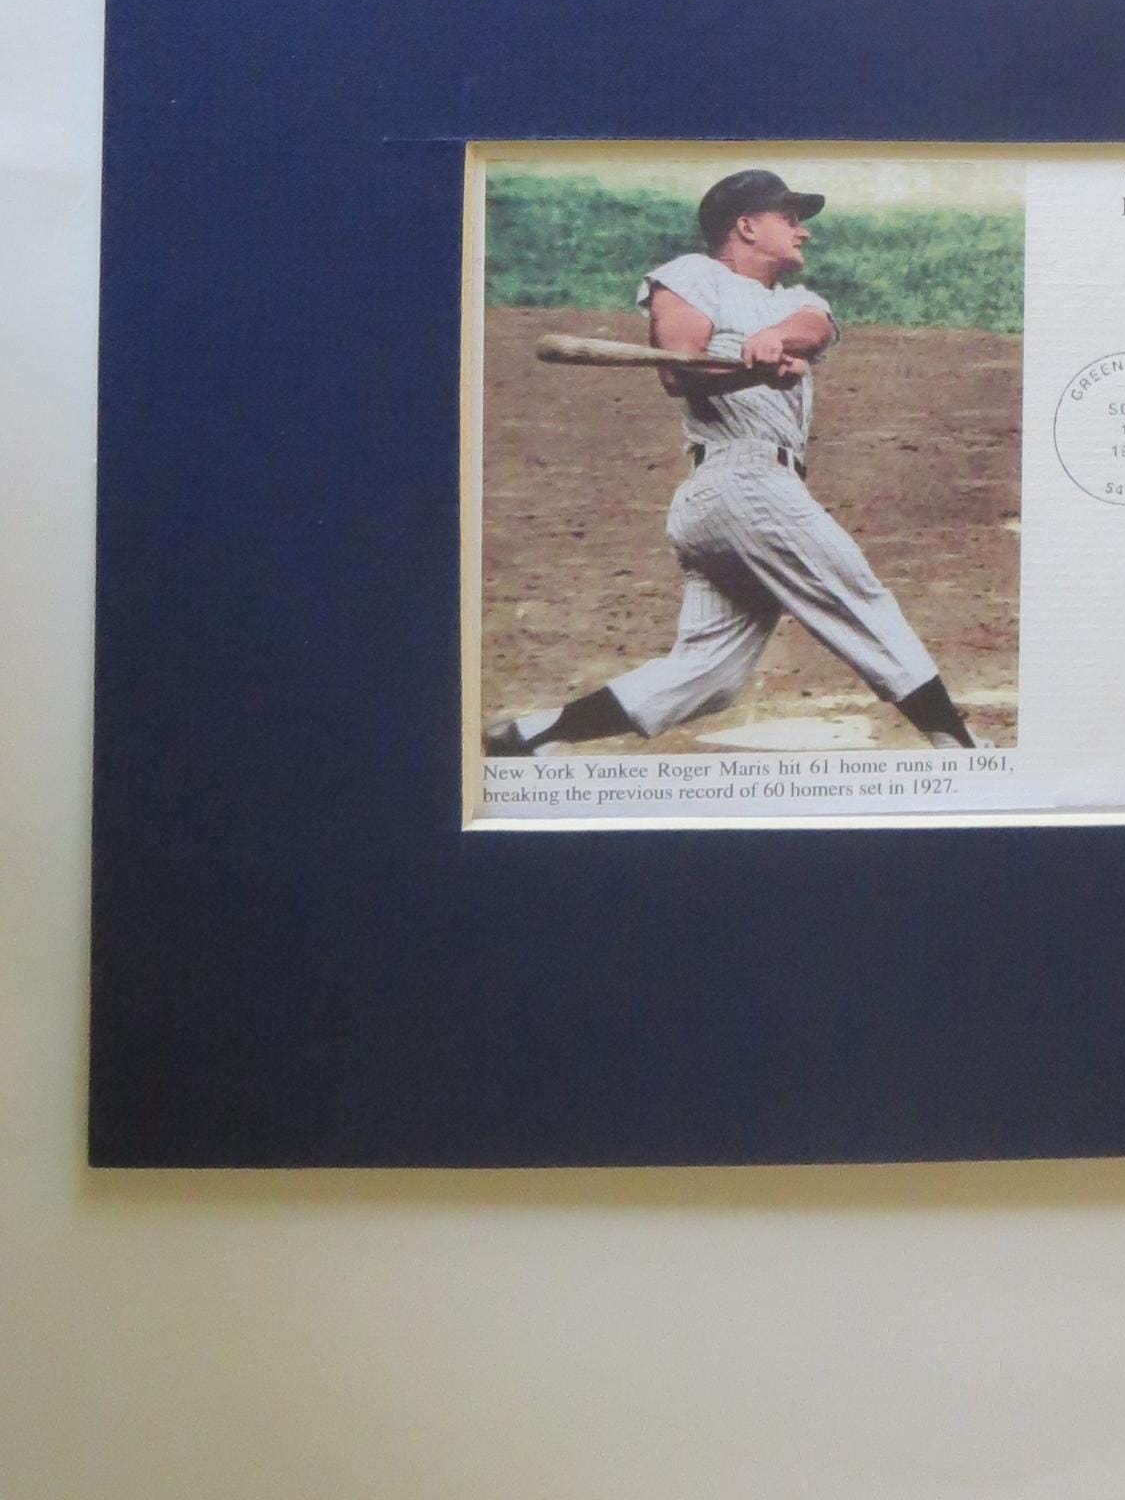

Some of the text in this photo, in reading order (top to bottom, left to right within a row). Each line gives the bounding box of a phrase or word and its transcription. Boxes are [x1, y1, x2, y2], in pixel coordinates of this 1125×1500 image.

[1070, 359, 1123, 401] GREEN
[483, 764, 525, 780] New
[534, 763, 575, 779] York
[585, 762, 649, 779] Yankee
[657, 761, 712, 782] Roger
[719, 760, 770, 777] Maris
[778, 759, 800, 775] hit
[809, 758, 829, 774] 61
[840, 758, 887, 773] home
[896, 760, 933, 772] runs
[942, 757, 958, 771] in
[483, 777, 958, 806] breaking the previous record of 60 homers set in 1927.
